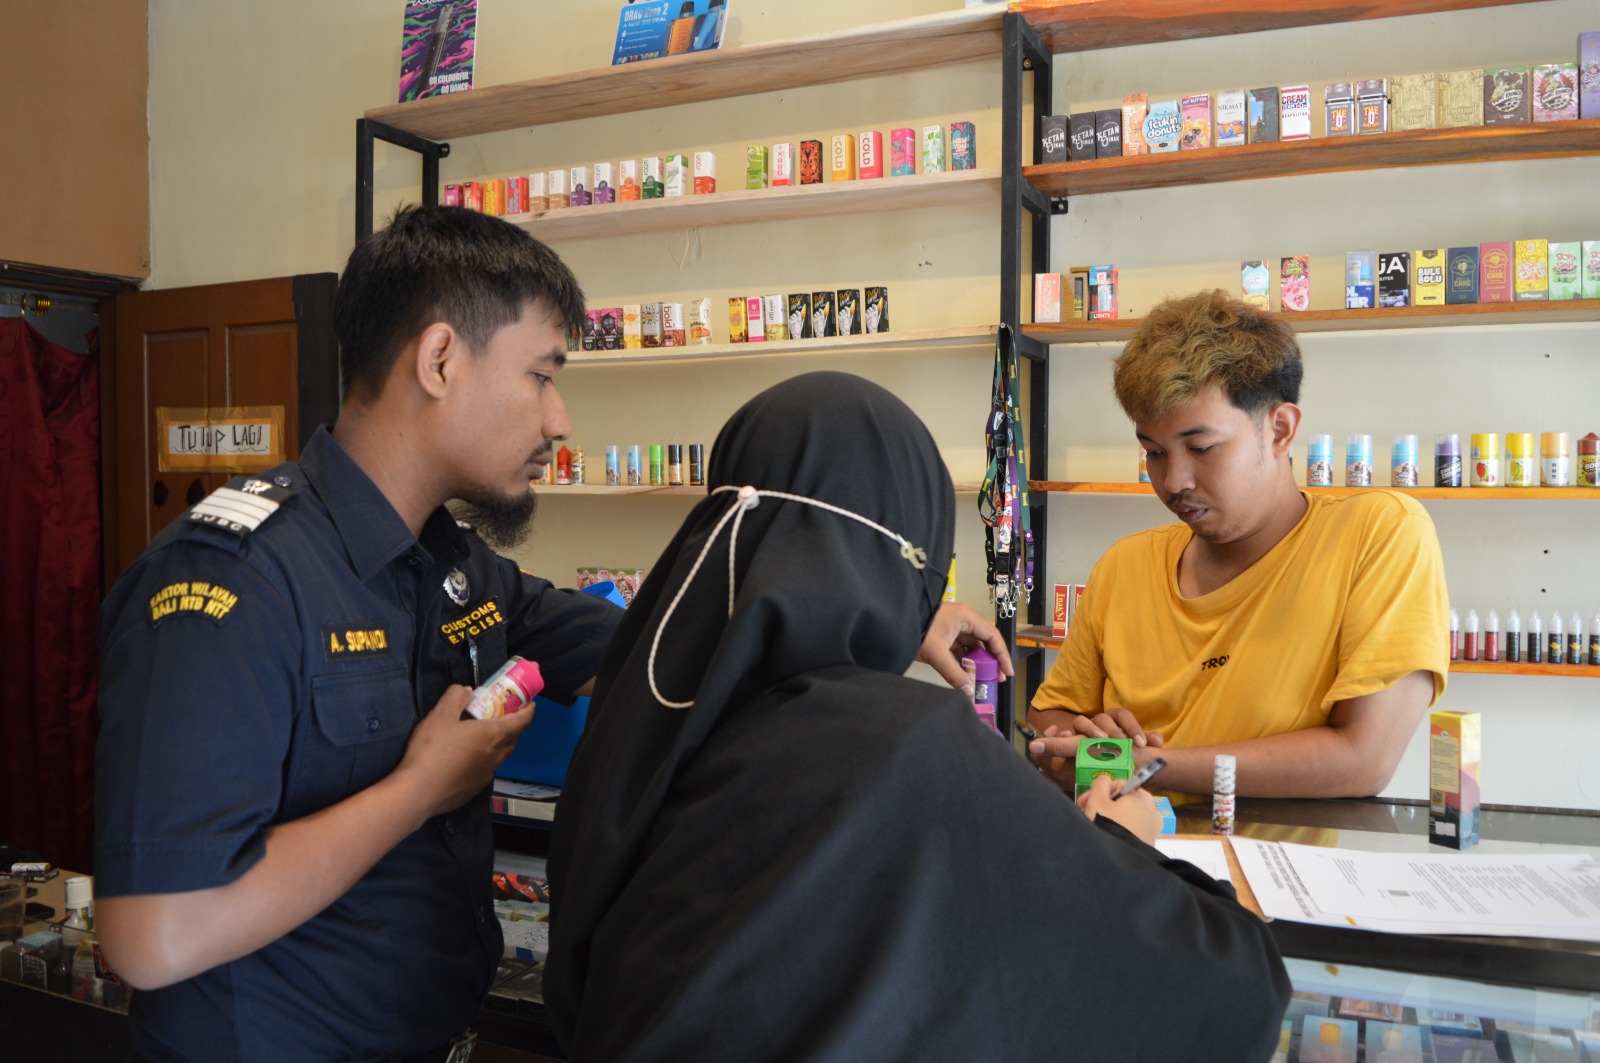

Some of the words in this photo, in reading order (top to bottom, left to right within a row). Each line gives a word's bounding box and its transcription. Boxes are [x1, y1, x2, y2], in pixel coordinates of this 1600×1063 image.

[662, 3, 669, 15] 2
[428, 76, 438, 85] GO
[440, 85, 451, 94] GO
[1281, 94, 1307, 105] CREAM
[1218, 103, 1243, 112] NIKMAT
[1071, 129, 1094, 144] KETAN
[1096, 126, 1120, 141] KETAN
[1147, 124, 1181, 138] donuts
[1042, 132, 1065, 148] KETAN
[862, 137, 871, 166] COLD
[1418, 267, 1442, 277] BULE
[664, 306, 673, 329] bold
[178, 425, 226, 455] TUTUP
[233, 424, 262, 447] LAGI
[191, 582, 239, 609] WILAYAH
[152, 597, 177, 620] BALI
[179, 595, 205, 611] NTB
[204, 599, 230, 619] NTT
[441, 601, 496, 634] CUSTOMS
[331, 632, 344, 653] A.
[345, 629, 388, 651] SUPANDI
